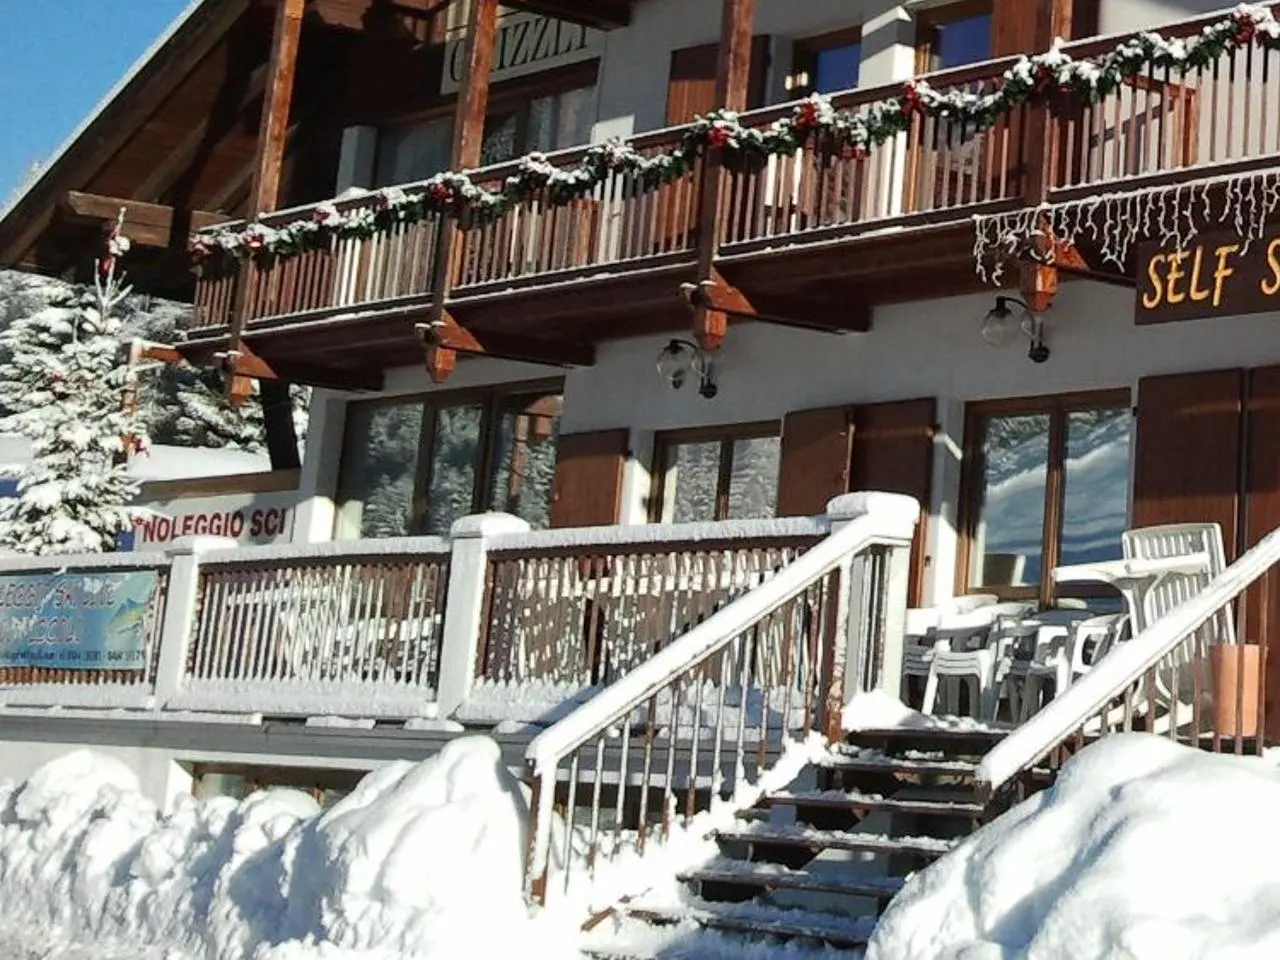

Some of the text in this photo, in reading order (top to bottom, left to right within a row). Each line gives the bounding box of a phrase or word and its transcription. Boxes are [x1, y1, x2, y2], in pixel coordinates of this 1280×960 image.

[450, 15, 589, 83] IZZLY
[1142, 243, 1240, 309] SELF
[142, 507, 287, 543] NOLEGGIO SCI
